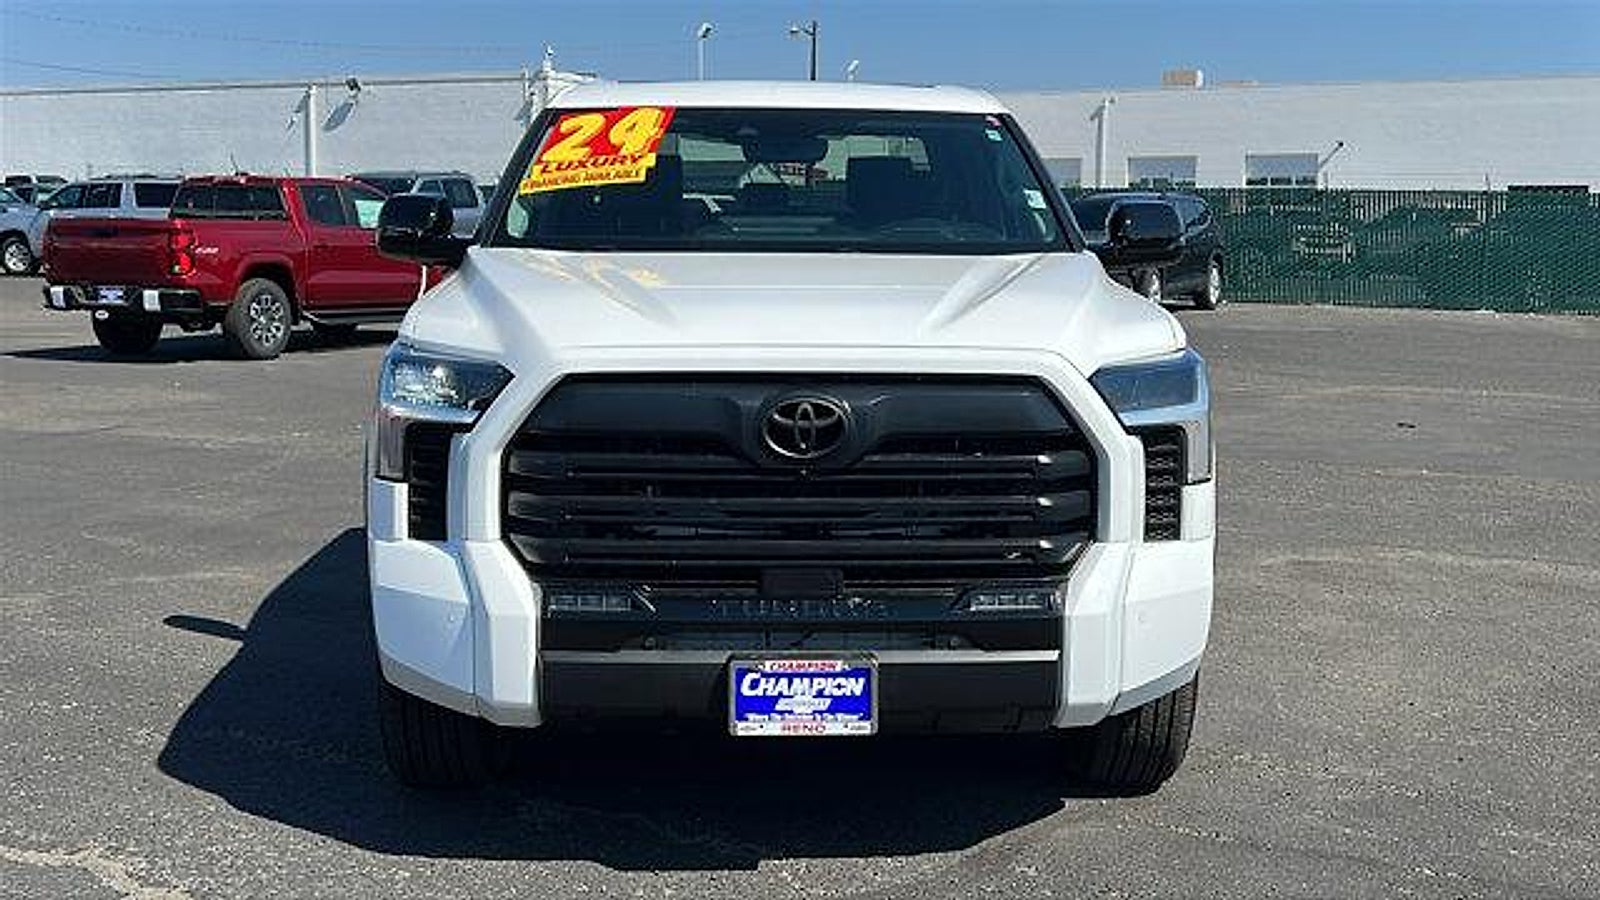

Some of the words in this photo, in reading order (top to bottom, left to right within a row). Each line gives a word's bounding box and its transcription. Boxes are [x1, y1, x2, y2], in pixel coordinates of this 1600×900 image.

[540, 153, 644, 174] LUXURY
[769, 661, 839, 672] CHAMPION
[740, 672, 866, 696] CHAMPION
